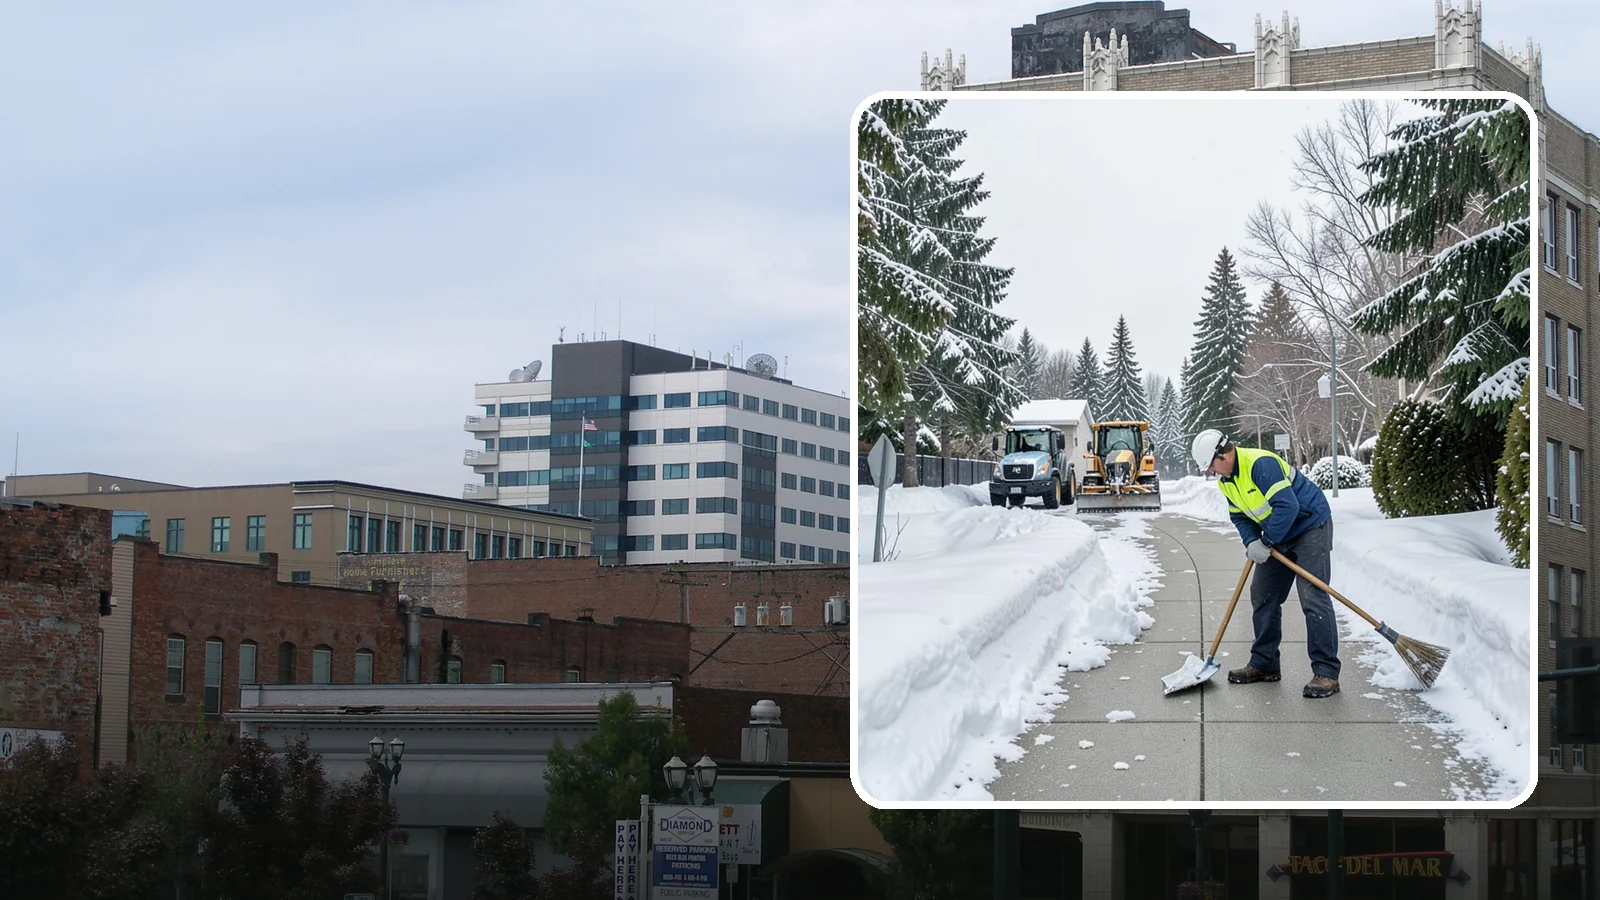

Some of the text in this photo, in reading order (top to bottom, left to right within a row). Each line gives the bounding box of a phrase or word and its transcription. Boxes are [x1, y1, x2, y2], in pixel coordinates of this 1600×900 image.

[370, 566, 427, 576] Furnishers
[660, 818, 713, 832] DIAMOND
[1022, 815, 1070, 828] BUILDING
[719, 824, 740, 835] ETT
[656, 845, 687, 853] RESERVED
[719, 839, 739, 848] ANT
[616, 825, 625, 893] PAY HERE
[628, 825, 637, 893] PAY HERE
[721, 851, 739, 863] Soup
[671, 862, 701, 870] PATRONS
[1289, 855, 1443, 877] TAC DEL MAR
[660, 888, 710, 898] PUBLIC PARKING
